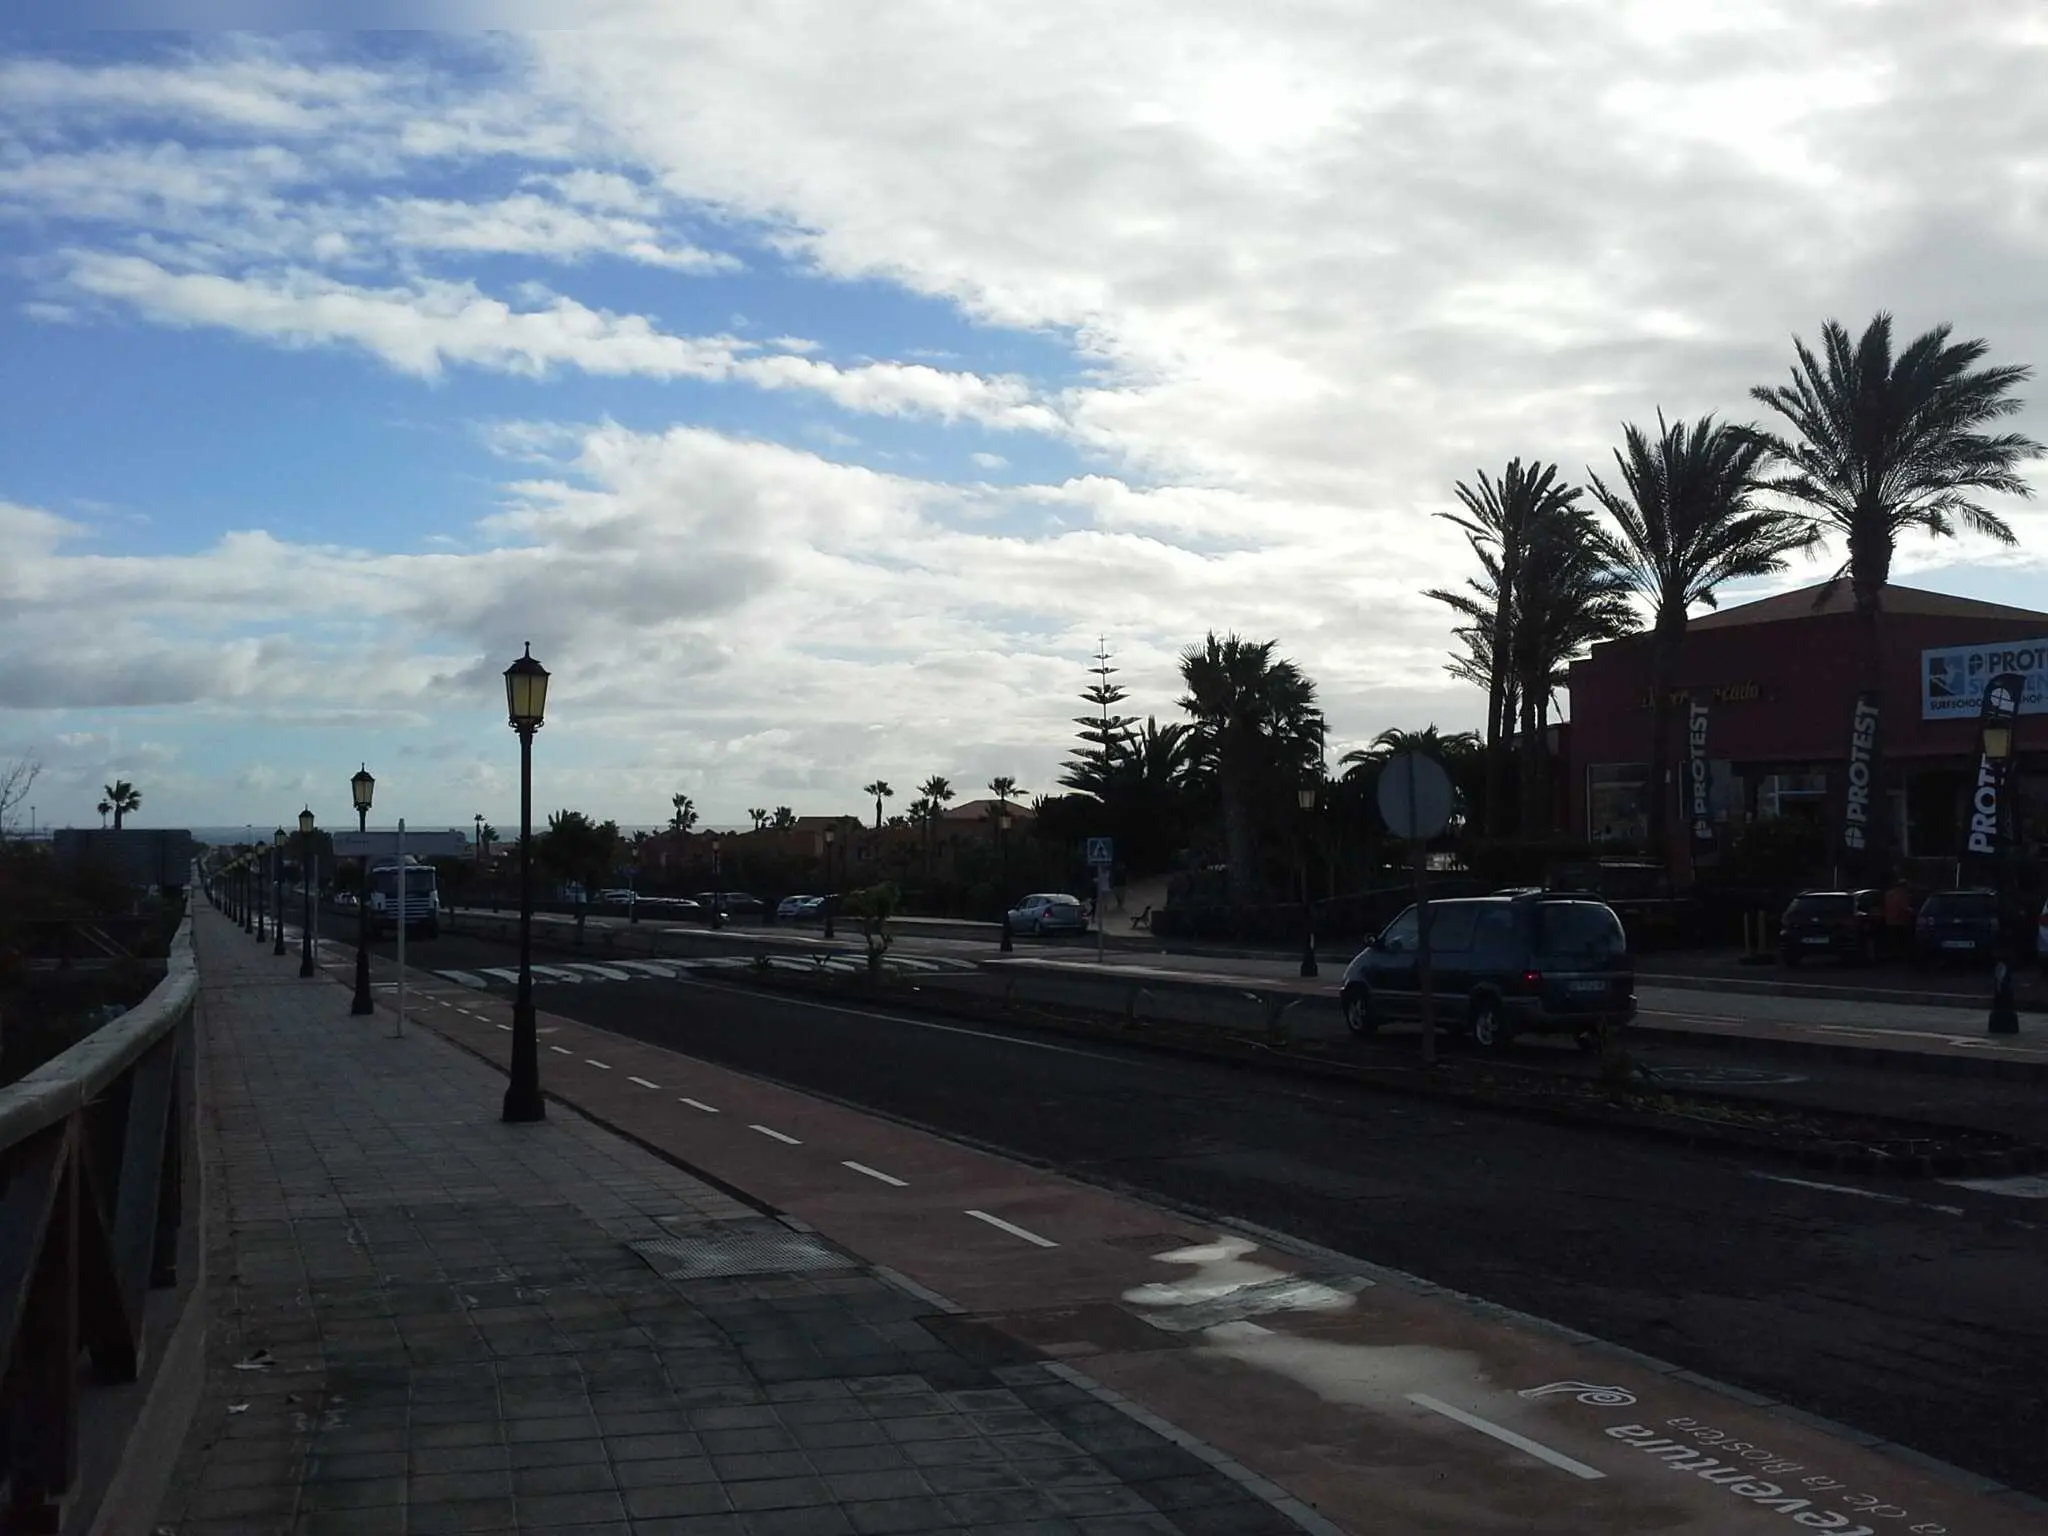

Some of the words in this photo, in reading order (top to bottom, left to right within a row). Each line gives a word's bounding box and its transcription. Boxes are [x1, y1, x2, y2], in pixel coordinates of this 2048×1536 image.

[1989, 648, 2048, 673] PROT
[1930, 697, 1983, 711] SURFSCHOO
[1689, 701, 1710, 815] PROTEST
[1846, 698, 1881, 823] PROTEST
[1666, 1416, 1805, 1475] Biosfera
[1801, 1475, 1847, 1491] la
[1842, 1492, 1908, 1518] de
